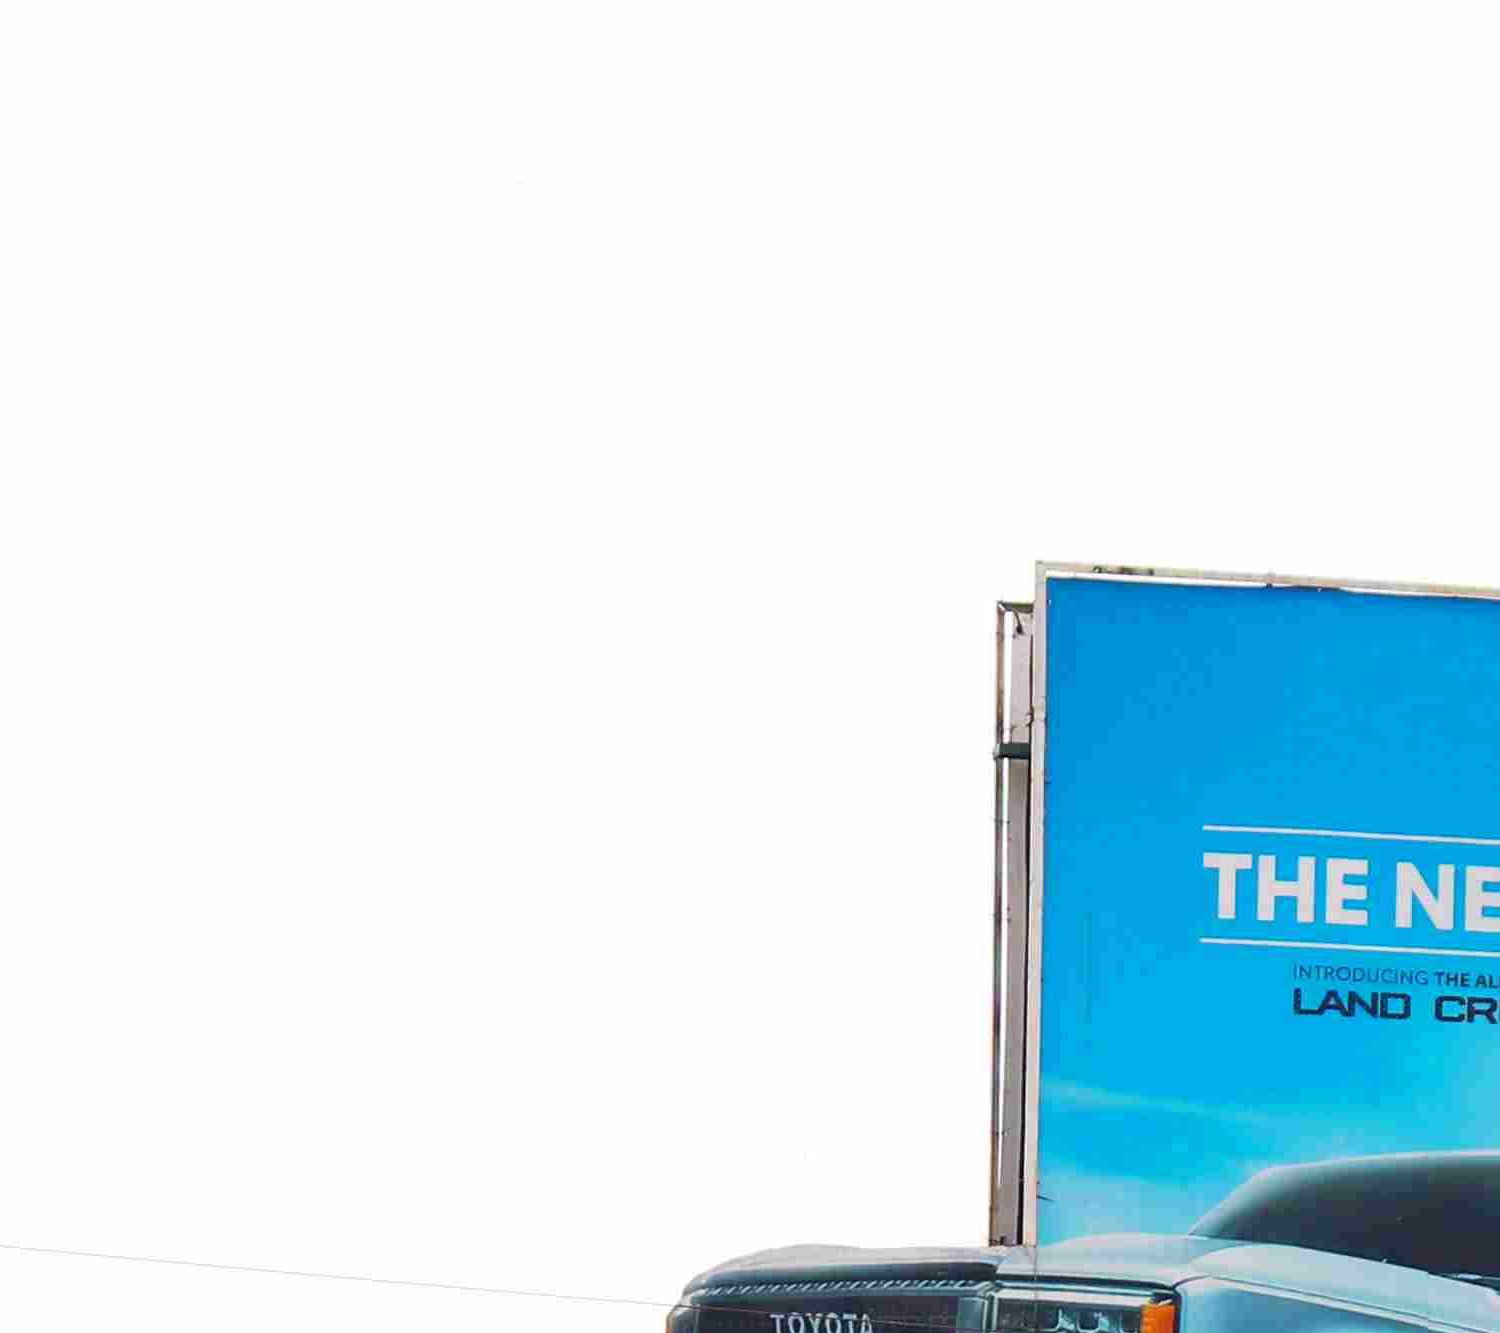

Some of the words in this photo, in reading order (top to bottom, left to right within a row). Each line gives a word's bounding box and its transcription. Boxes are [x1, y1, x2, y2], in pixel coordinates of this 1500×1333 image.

[1203, 853, 1368, 926] THE
[1292, 962, 1429, 985] INTRODUCING
[1433, 971, 1472, 987] THE
[1292, 989, 1411, 1020] LAND
